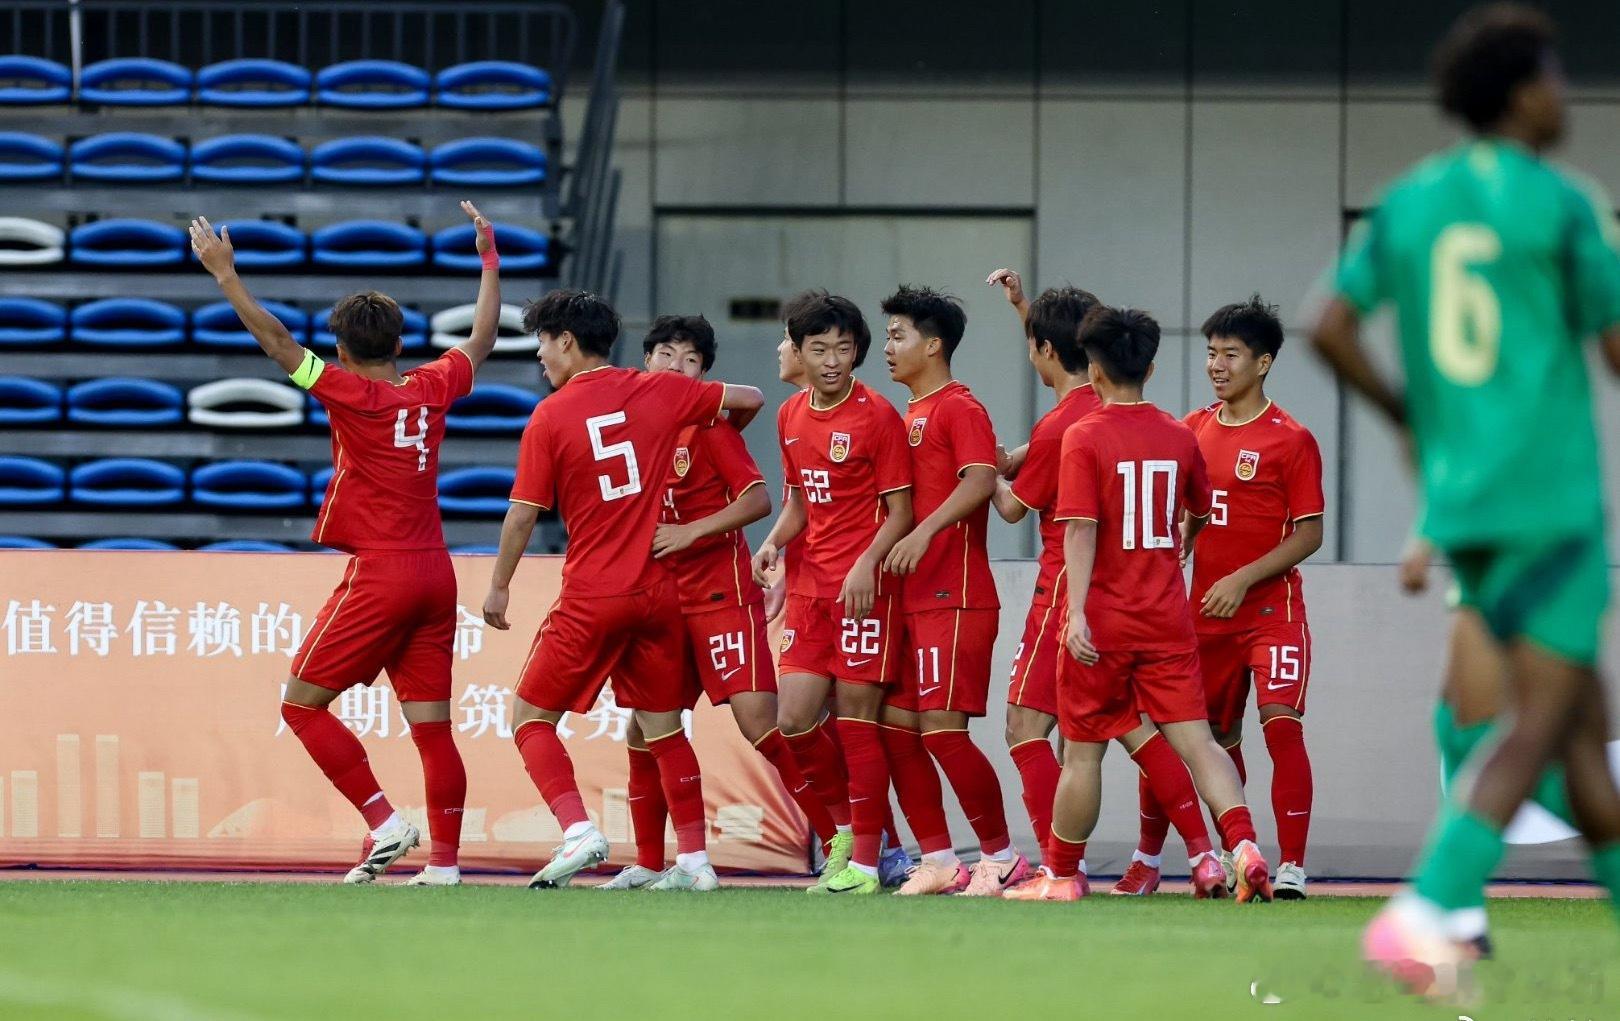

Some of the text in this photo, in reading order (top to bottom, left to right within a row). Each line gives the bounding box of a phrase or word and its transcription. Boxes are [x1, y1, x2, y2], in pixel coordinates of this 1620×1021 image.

[1428, 222, 1502, 386] 6
[394, 406, 429, 471] 4
[586, 411, 641, 501] 5
[801, 469, 832, 503] 22
[1117, 460, 1178, 549] 10
[1206, 490, 1228, 526] 5
[709, 631, 745, 671] 24
[841, 618, 881, 654] 22
[917, 647, 940, 684] 11
[1269, 645, 1299, 681] 15
